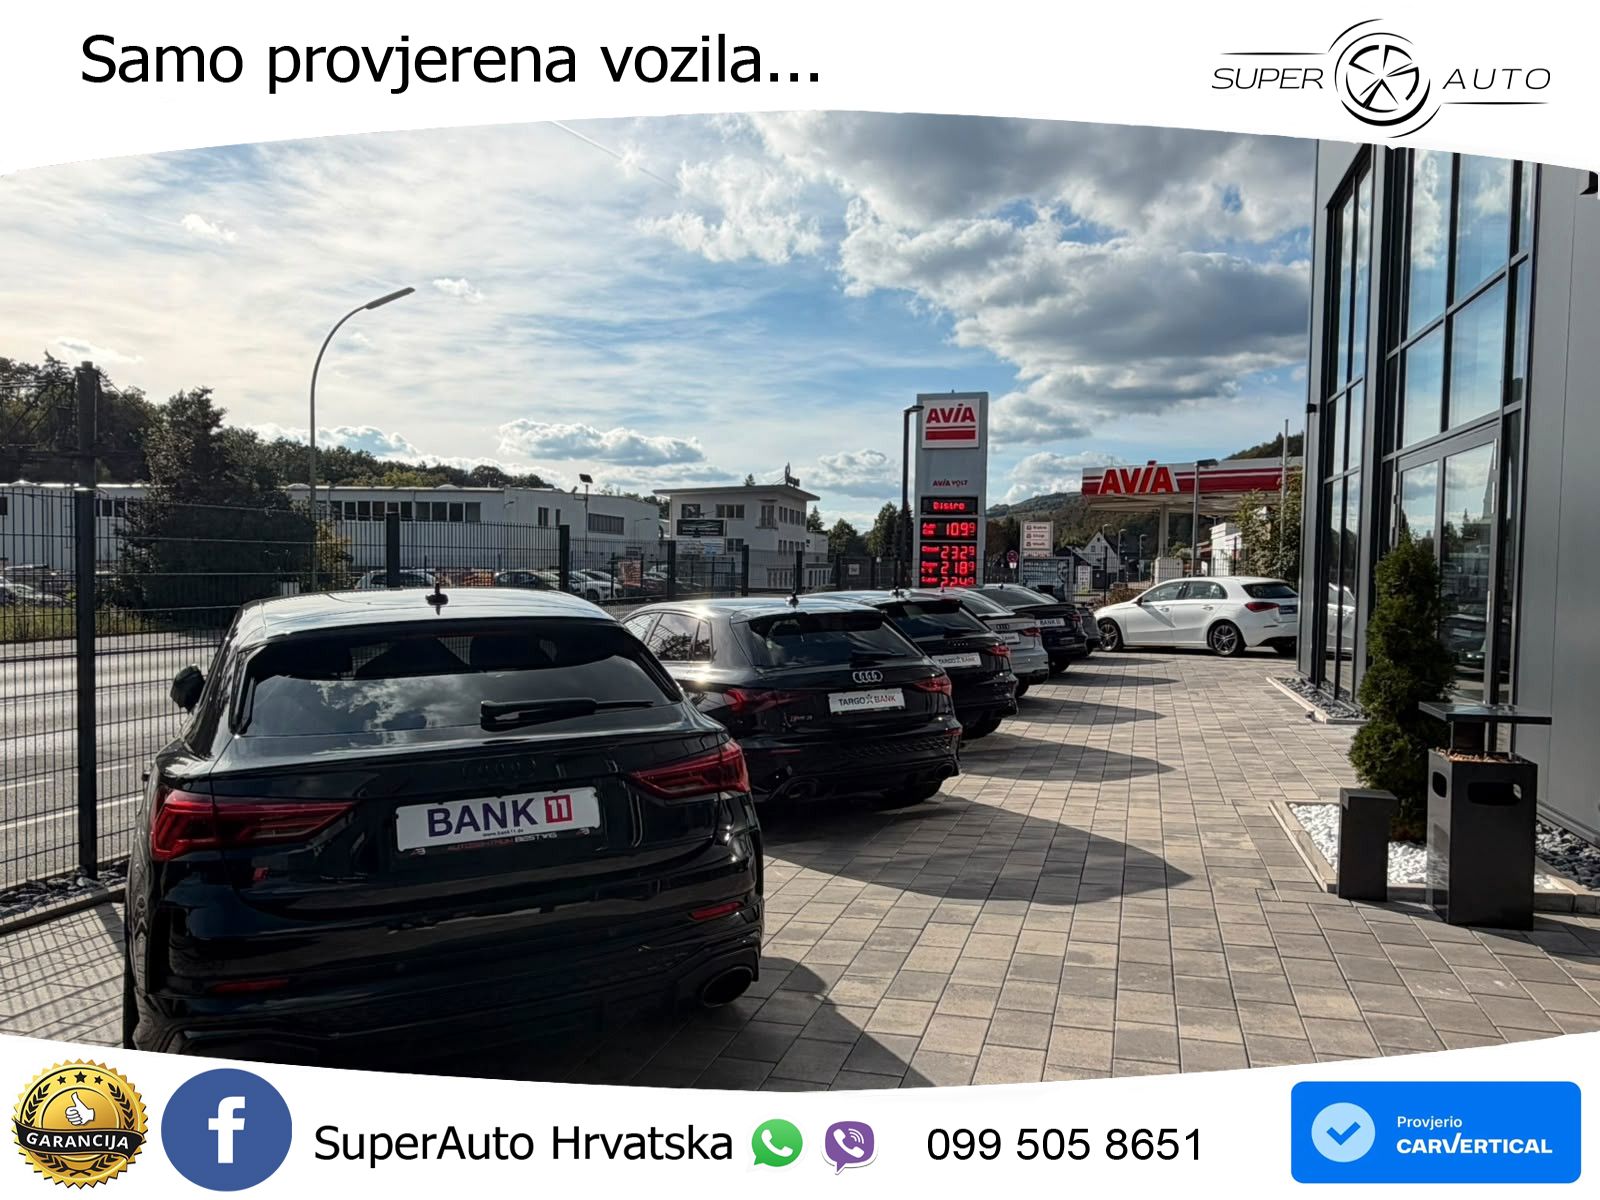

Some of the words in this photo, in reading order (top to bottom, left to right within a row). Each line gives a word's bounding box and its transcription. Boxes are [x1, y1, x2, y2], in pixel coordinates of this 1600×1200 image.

[838, 697, 866, 706] TARGO
[874, 695, 897, 704] BANK
[426, 798, 538, 838] BANK
